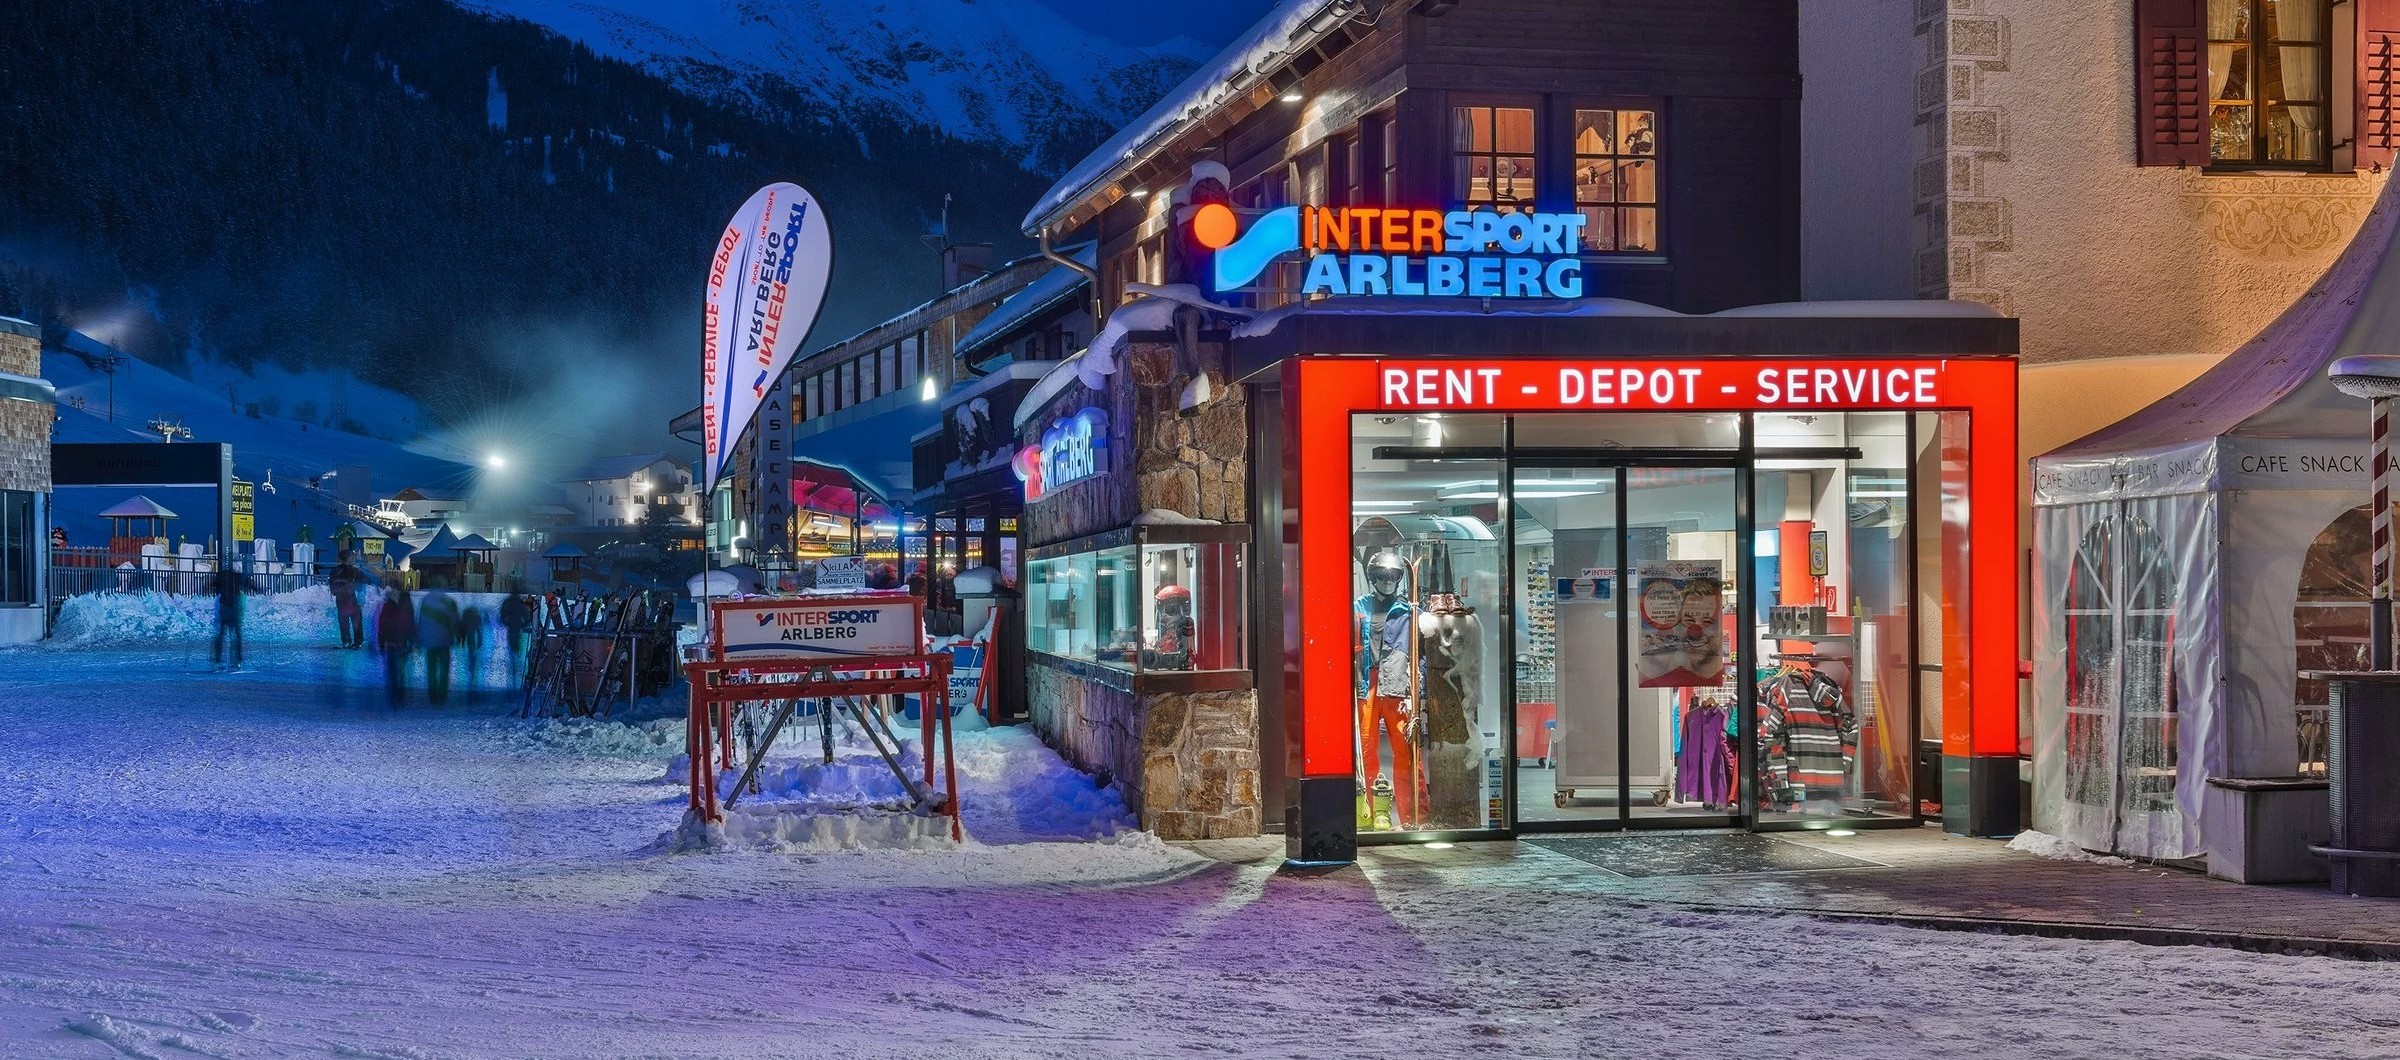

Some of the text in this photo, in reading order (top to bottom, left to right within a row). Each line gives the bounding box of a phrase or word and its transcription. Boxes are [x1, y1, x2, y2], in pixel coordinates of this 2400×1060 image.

[1304, 207, 1586, 254] INTERSPORT
[1302, 254, 1582, 298] ARLBERG
[1384, 369, 1501, 404] RENT
[1560, 369, 1702, 404] DEPOT
[1756, 369, 1937, 403] SERVICE
[2039, 458, 2211, 490] CAFE SNACK BAR SNACK
[2241, 455, 2289, 473] CAFE
[2300, 455, 2365, 473] SNACK
[777, 609, 880, 626] INTERSPORT
[781, 626, 857, 640] ARLBERG
